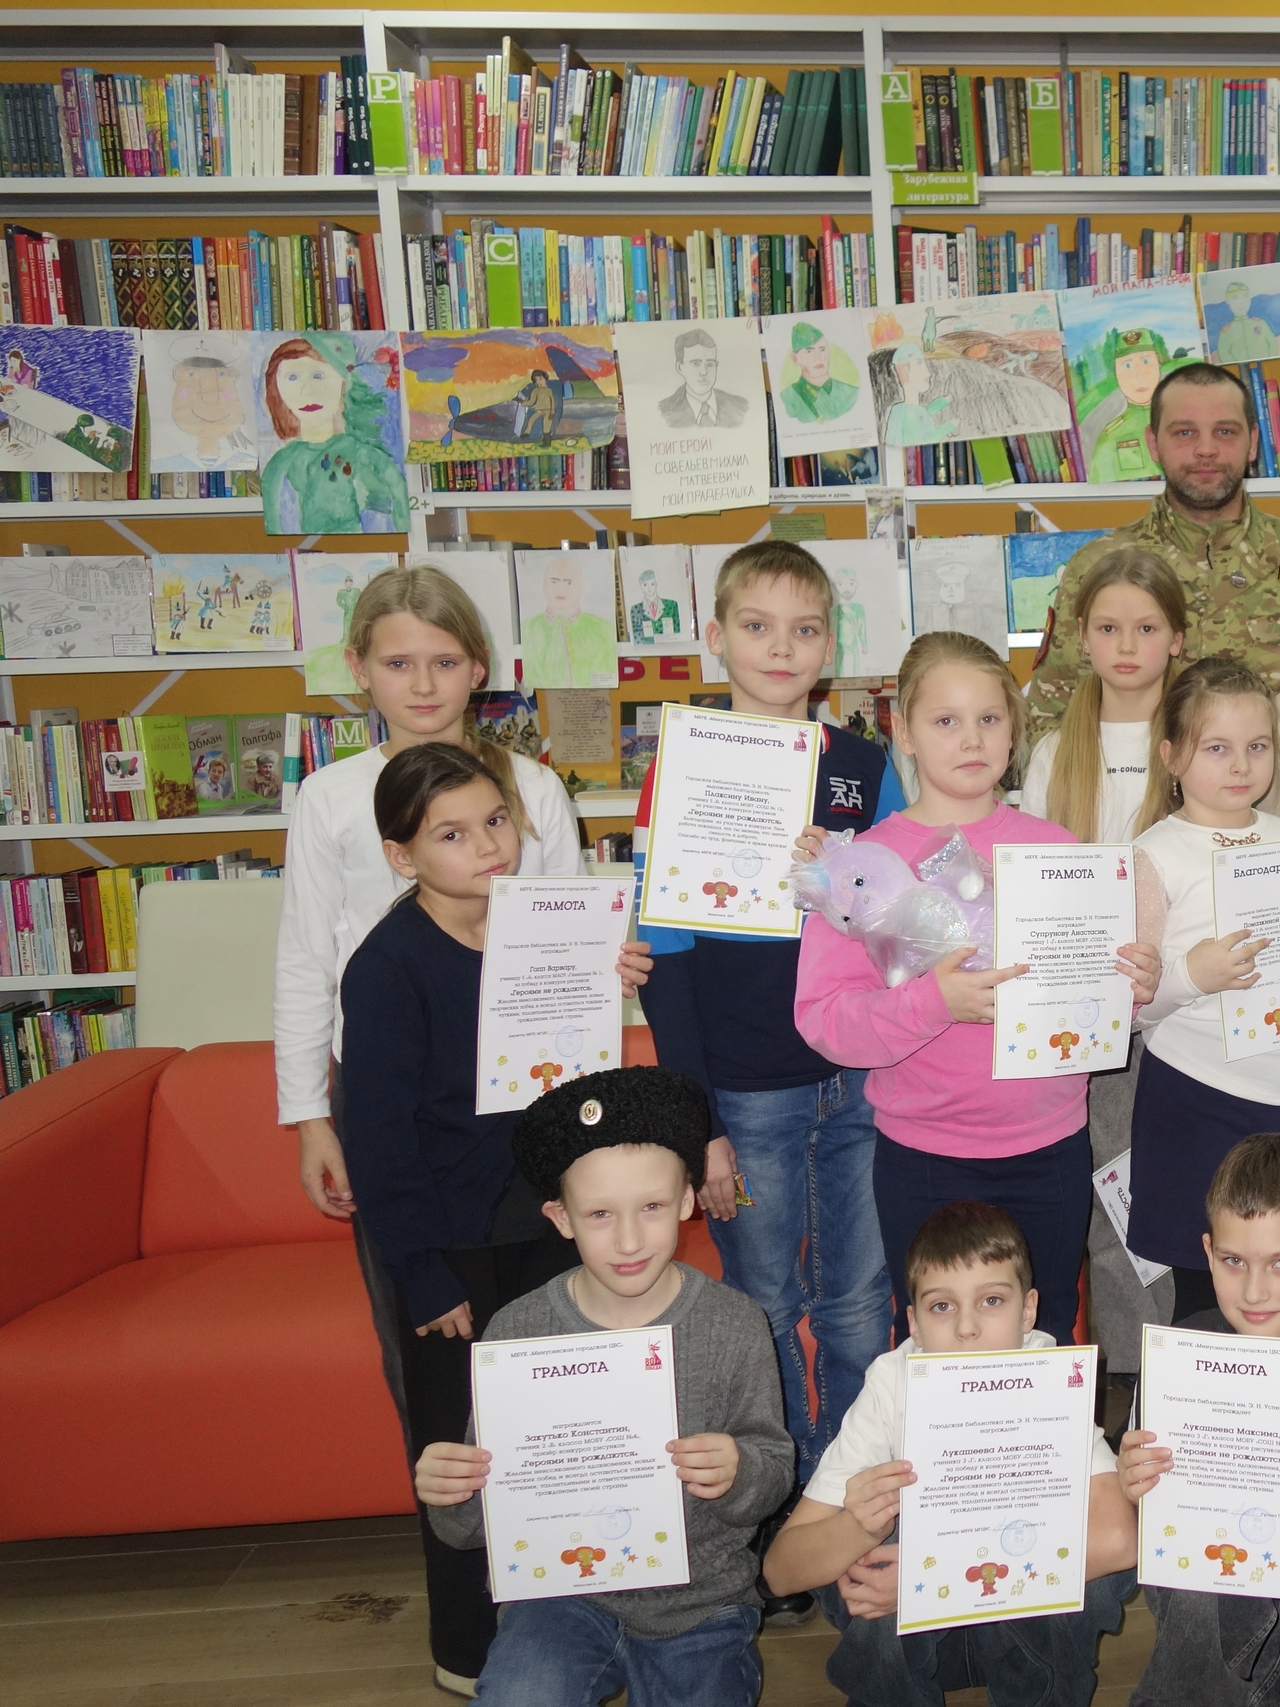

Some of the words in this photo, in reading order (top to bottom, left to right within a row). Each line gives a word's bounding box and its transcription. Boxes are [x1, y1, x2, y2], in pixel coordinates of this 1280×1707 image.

[371, 75, 397, 99] Р
[884, 76, 908, 99] А
[1036, 83, 1054, 105] Б
[903, 173, 968, 186] Зарубежная
[906, 192, 969, 203] литература
[489, 238, 513, 261] С
[424, 239, 433, 281] РЫБАКОВ
[1092, 283, 1119, 298] МОЙ
[680, 470, 740, 487] МАТВЕЕВИЧ
[409, 497, 430, 511] 2+
[662, 489, 684, 507] МОЙ
[687, 485, 755, 504] ПРАДЕДУШКА
[241, 729, 282, 747] Голгофа
[337, 721, 362, 743] М
[690, 728, 784, 747] Благодарность
[189, 733, 223, 751] Обман
[1041, 869, 1095, 879] ГРАМОТА
[532, 901, 586, 911] ГРАМОТА
[532, 1362, 609, 1379] ГРАМОТА
[1196, 1360, 1268, 1376] ГРАМОТА
[962, 1378, 1034, 1393] ГРАМОТА
